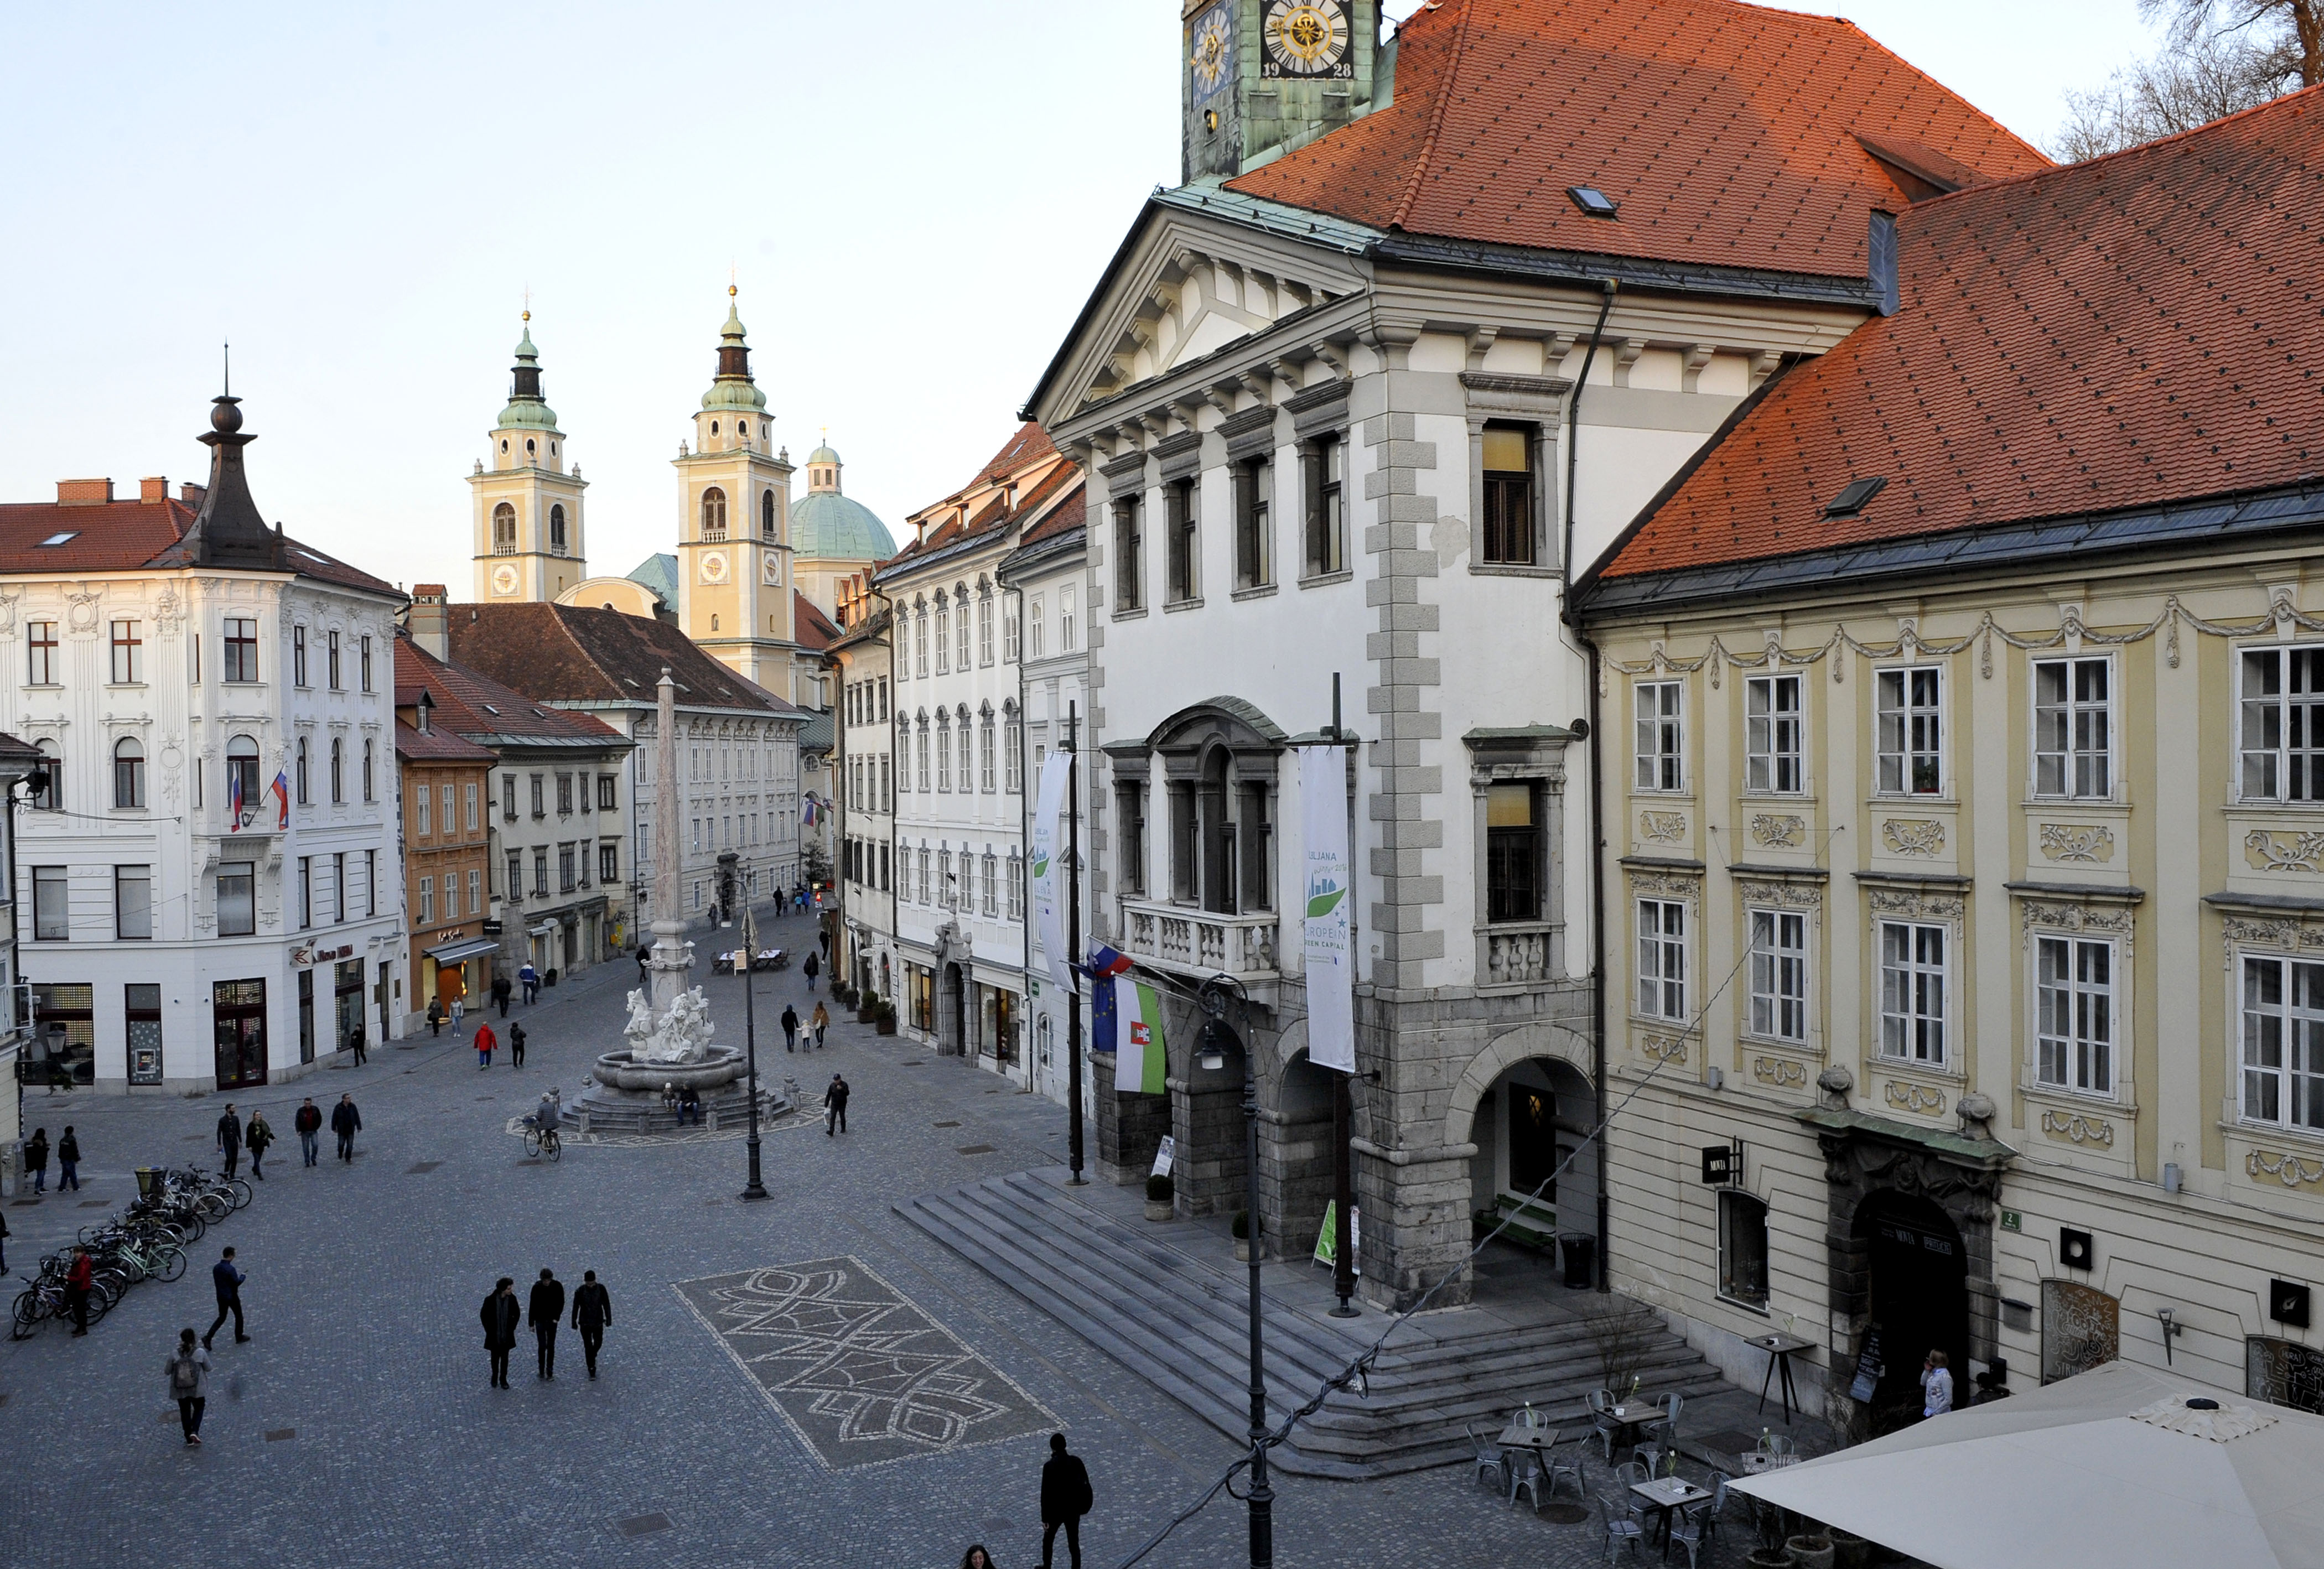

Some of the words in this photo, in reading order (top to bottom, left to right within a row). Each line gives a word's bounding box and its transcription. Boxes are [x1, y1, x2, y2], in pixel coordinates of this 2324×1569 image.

[1262, 63, 1279, 76] 19
[1333, 63, 1351, 77] 28
[1306, 927, 1346, 940] UROPEN
[2008, 1213, 2012, 1223] 2
